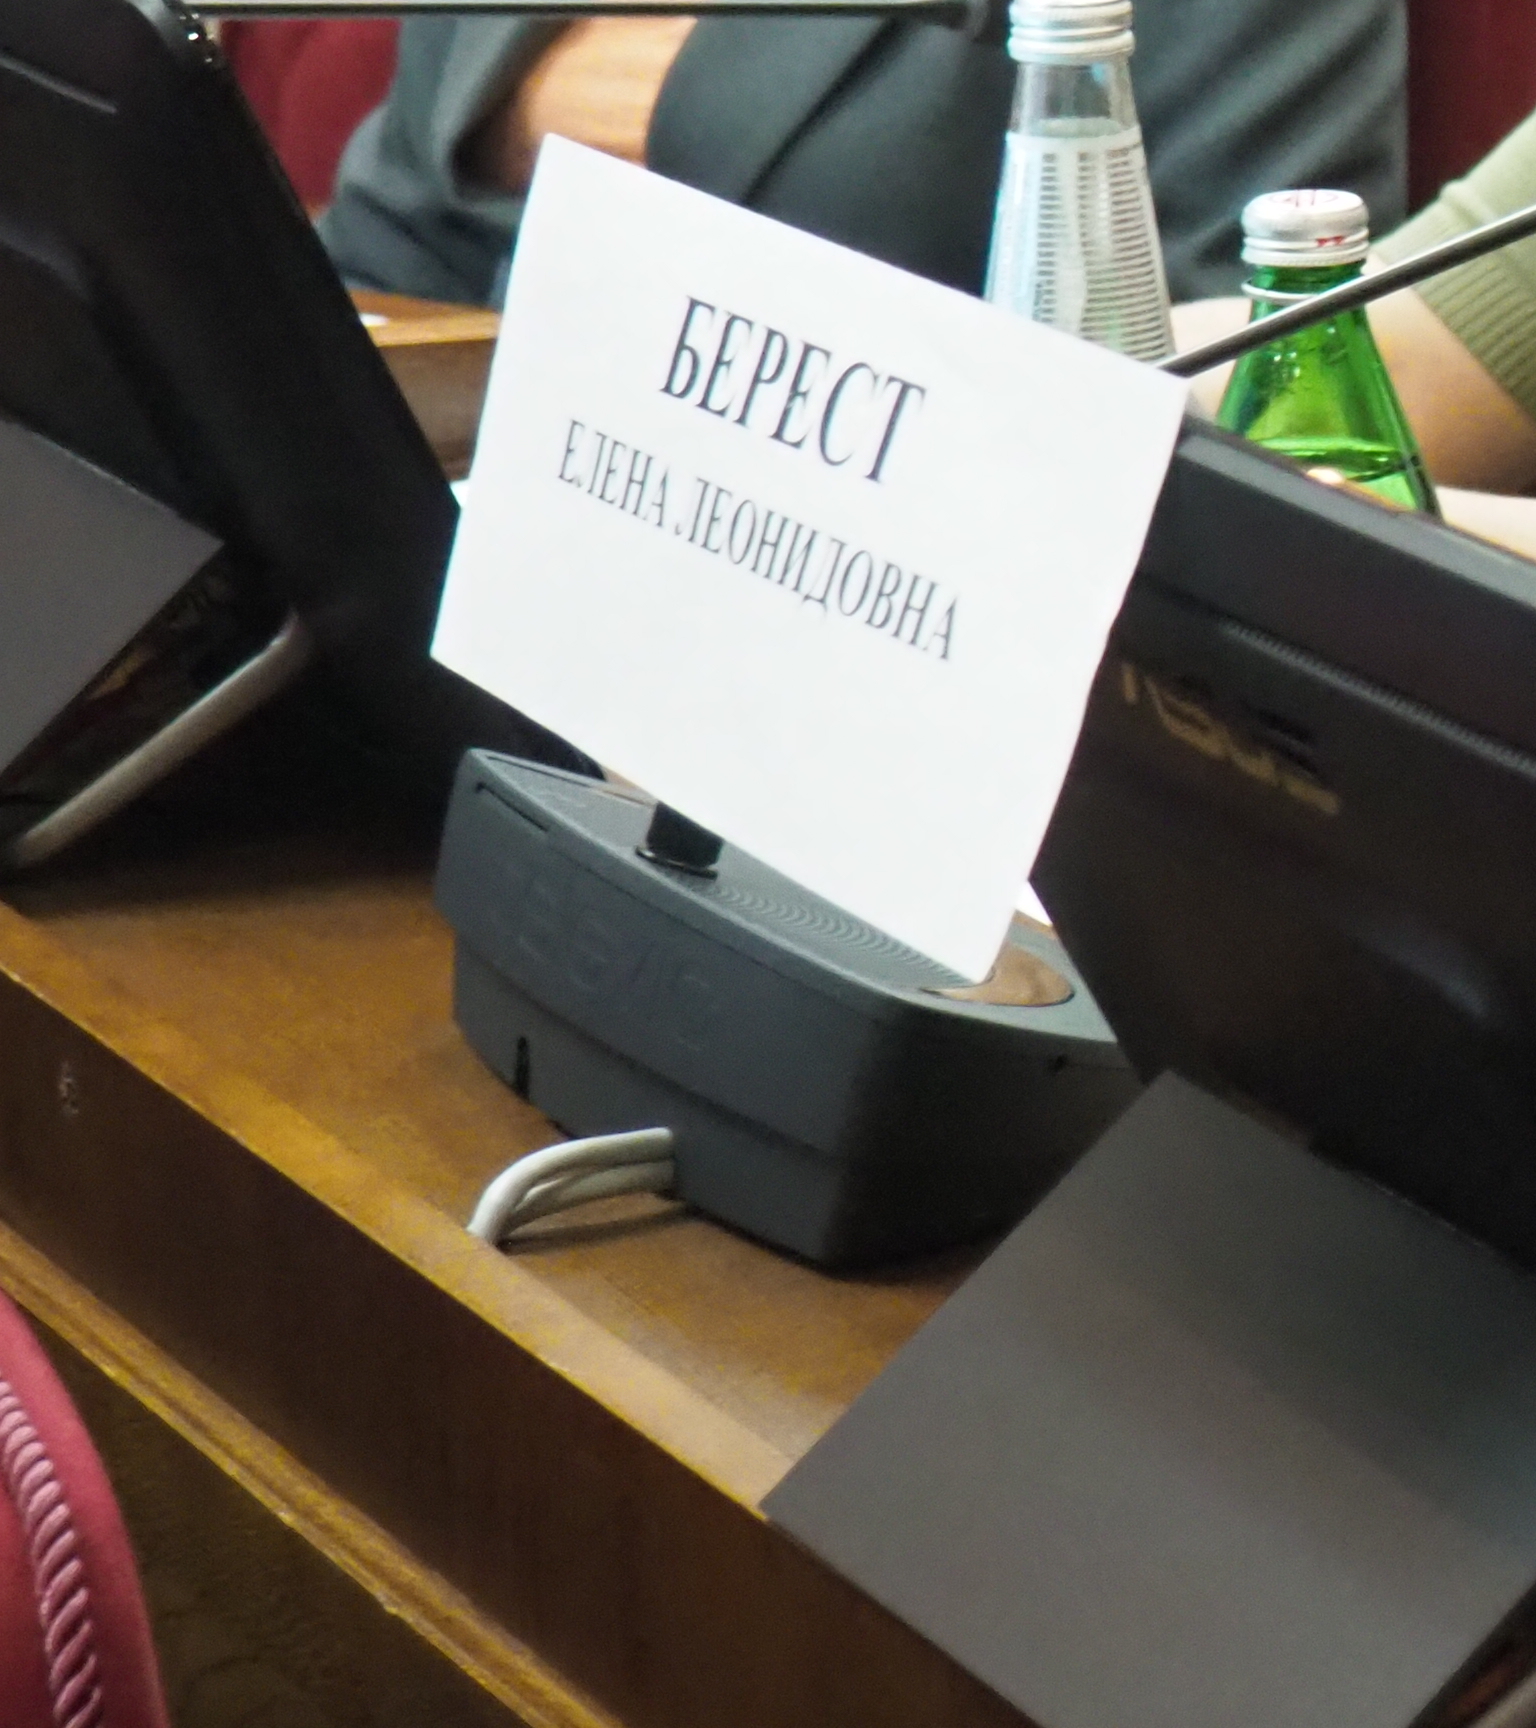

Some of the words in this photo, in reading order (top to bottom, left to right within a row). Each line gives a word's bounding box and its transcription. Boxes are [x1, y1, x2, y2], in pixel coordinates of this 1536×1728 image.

[658, 294, 927, 484] БЕРЕСТ
[556, 418, 672, 531] ЕЛЕНА
[675, 477, 963, 663] ЛЕОНИДОВНА
